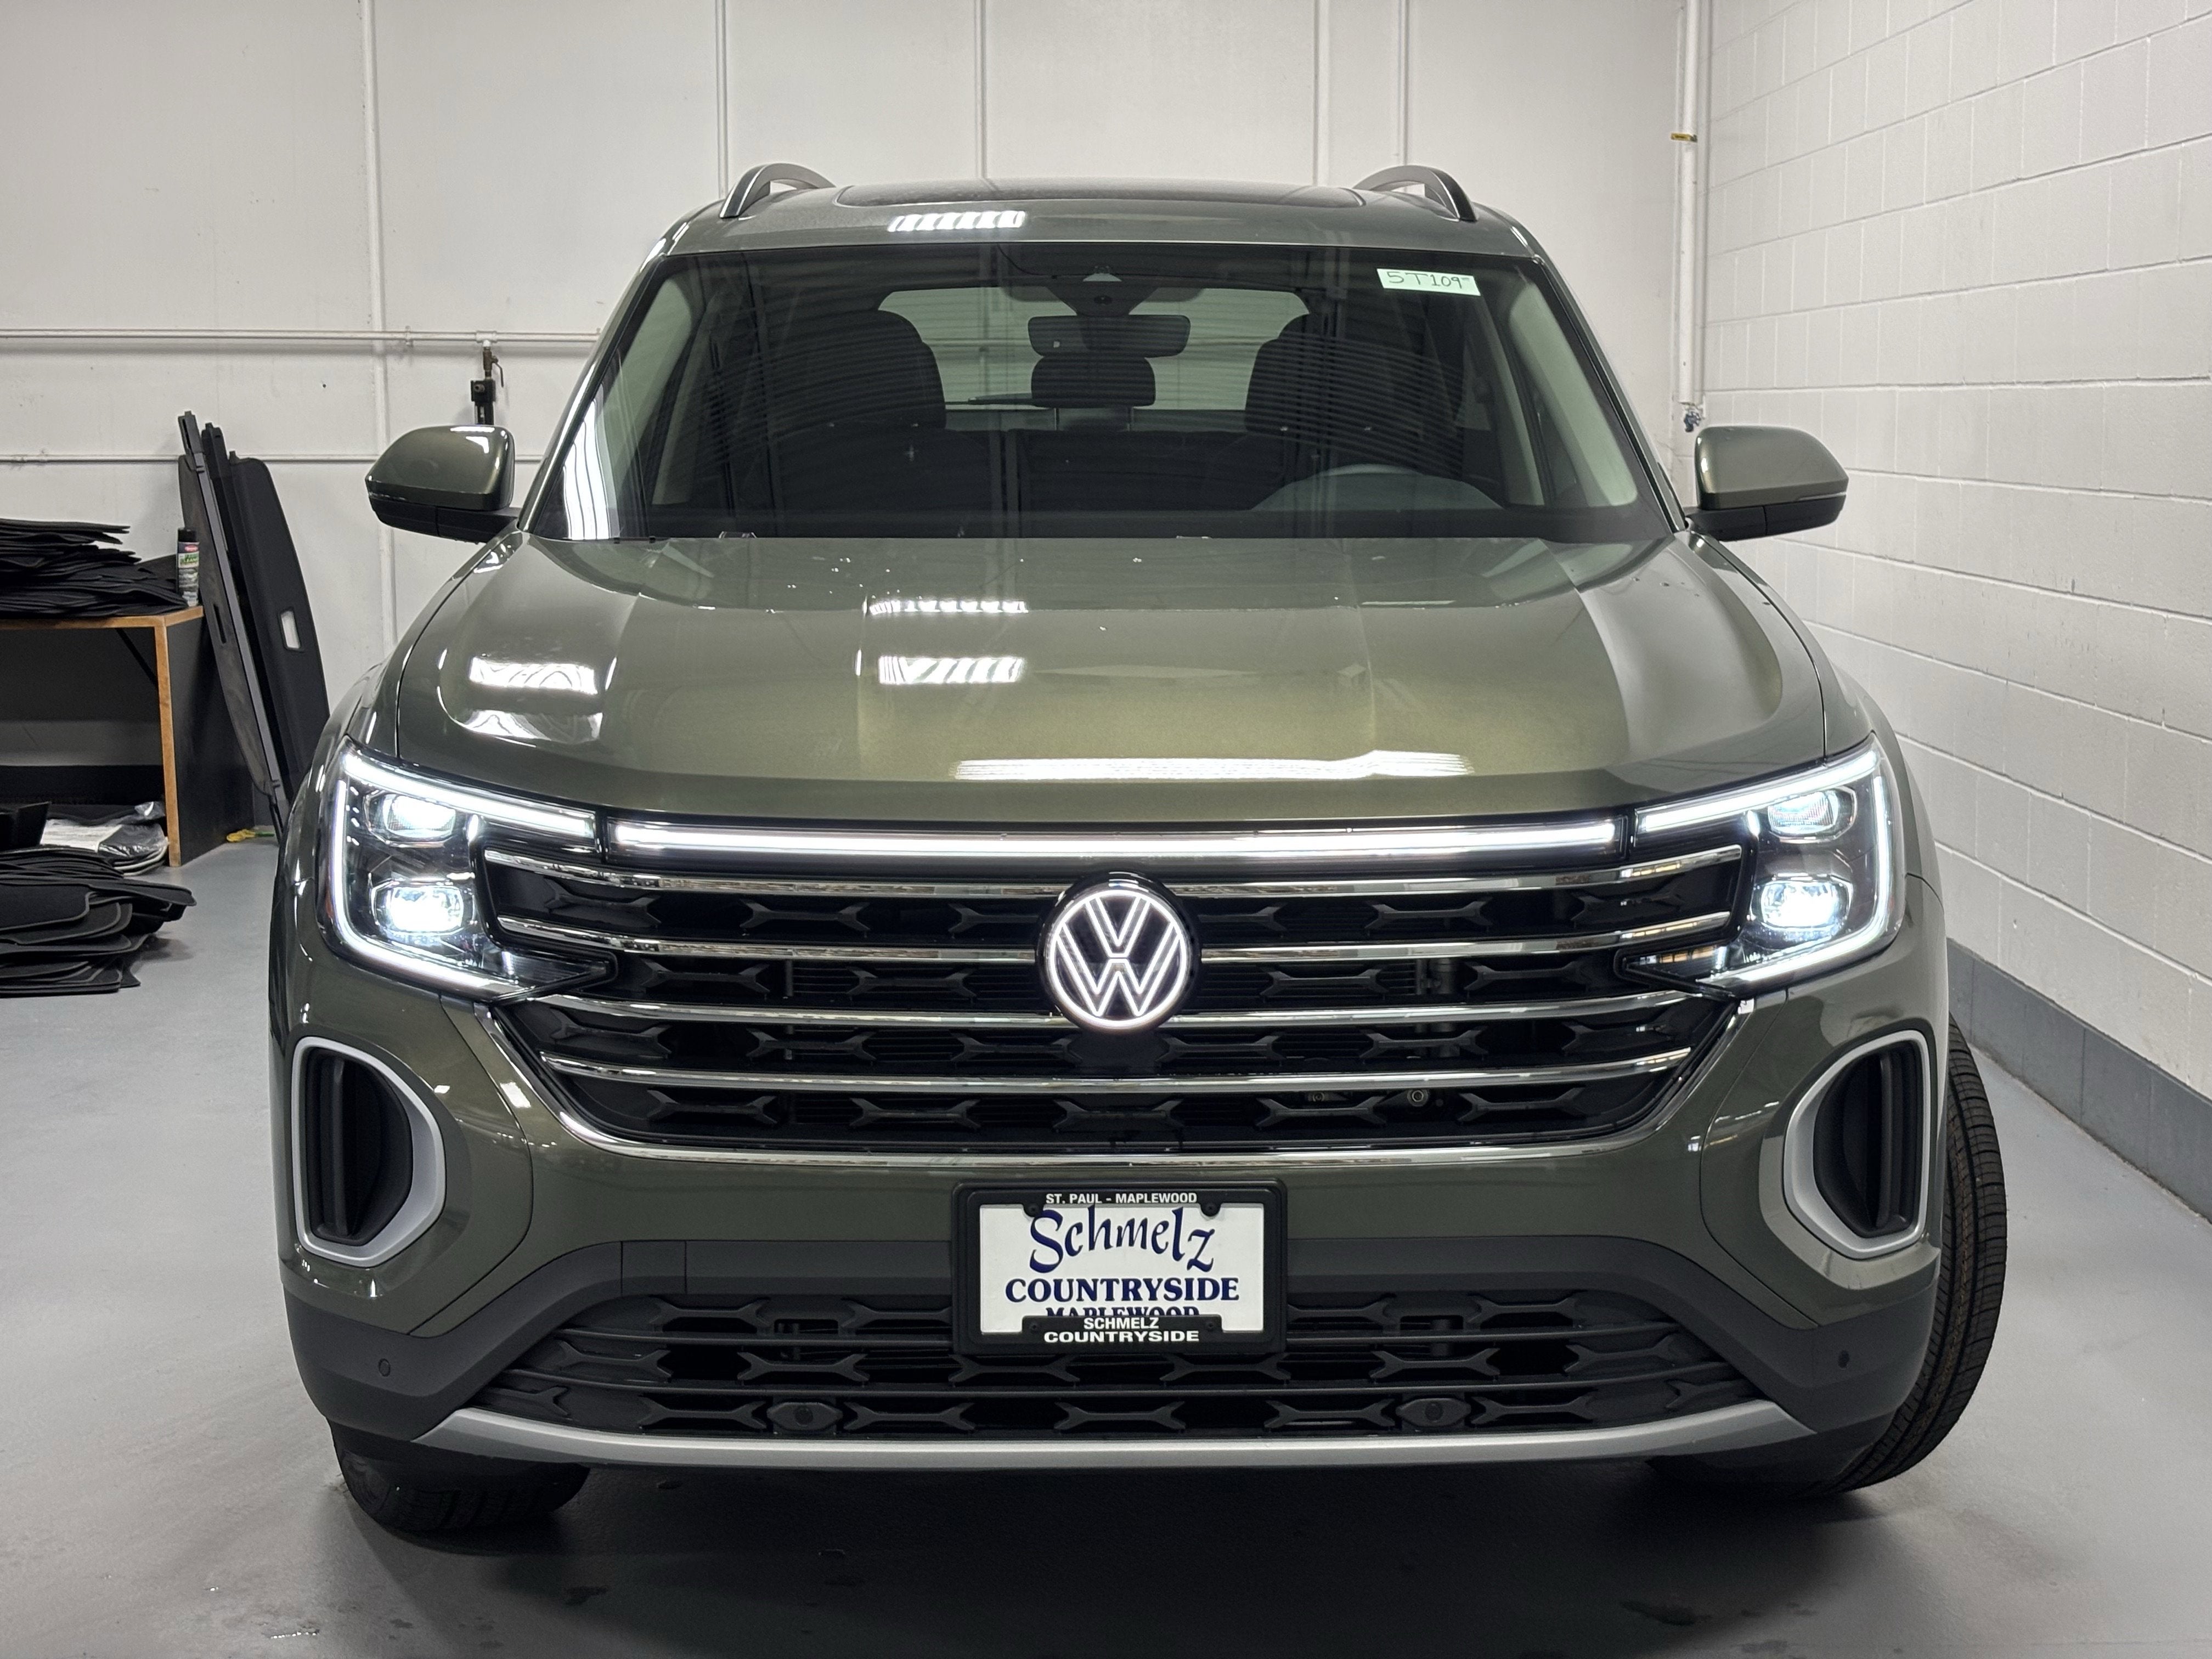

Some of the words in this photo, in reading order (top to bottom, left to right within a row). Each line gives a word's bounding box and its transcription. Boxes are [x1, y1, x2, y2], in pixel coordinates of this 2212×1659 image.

[1054, 895, 1181, 1017] VW
[1046, 1193, 1065, 1204] ST.
[1070, 1193, 1103, 1204] PAUL
[1115, 1193, 1197, 1203] MAPLEWOOD
[1029, 1205, 1216, 1273] Schmelz
[1005, 1277, 1239, 1302] COUNTRYSIDE
[1084, 1317, 1159, 1329] SCHMELZ
[1044, 1330, 1199, 1342] COUNTRYSIDE
